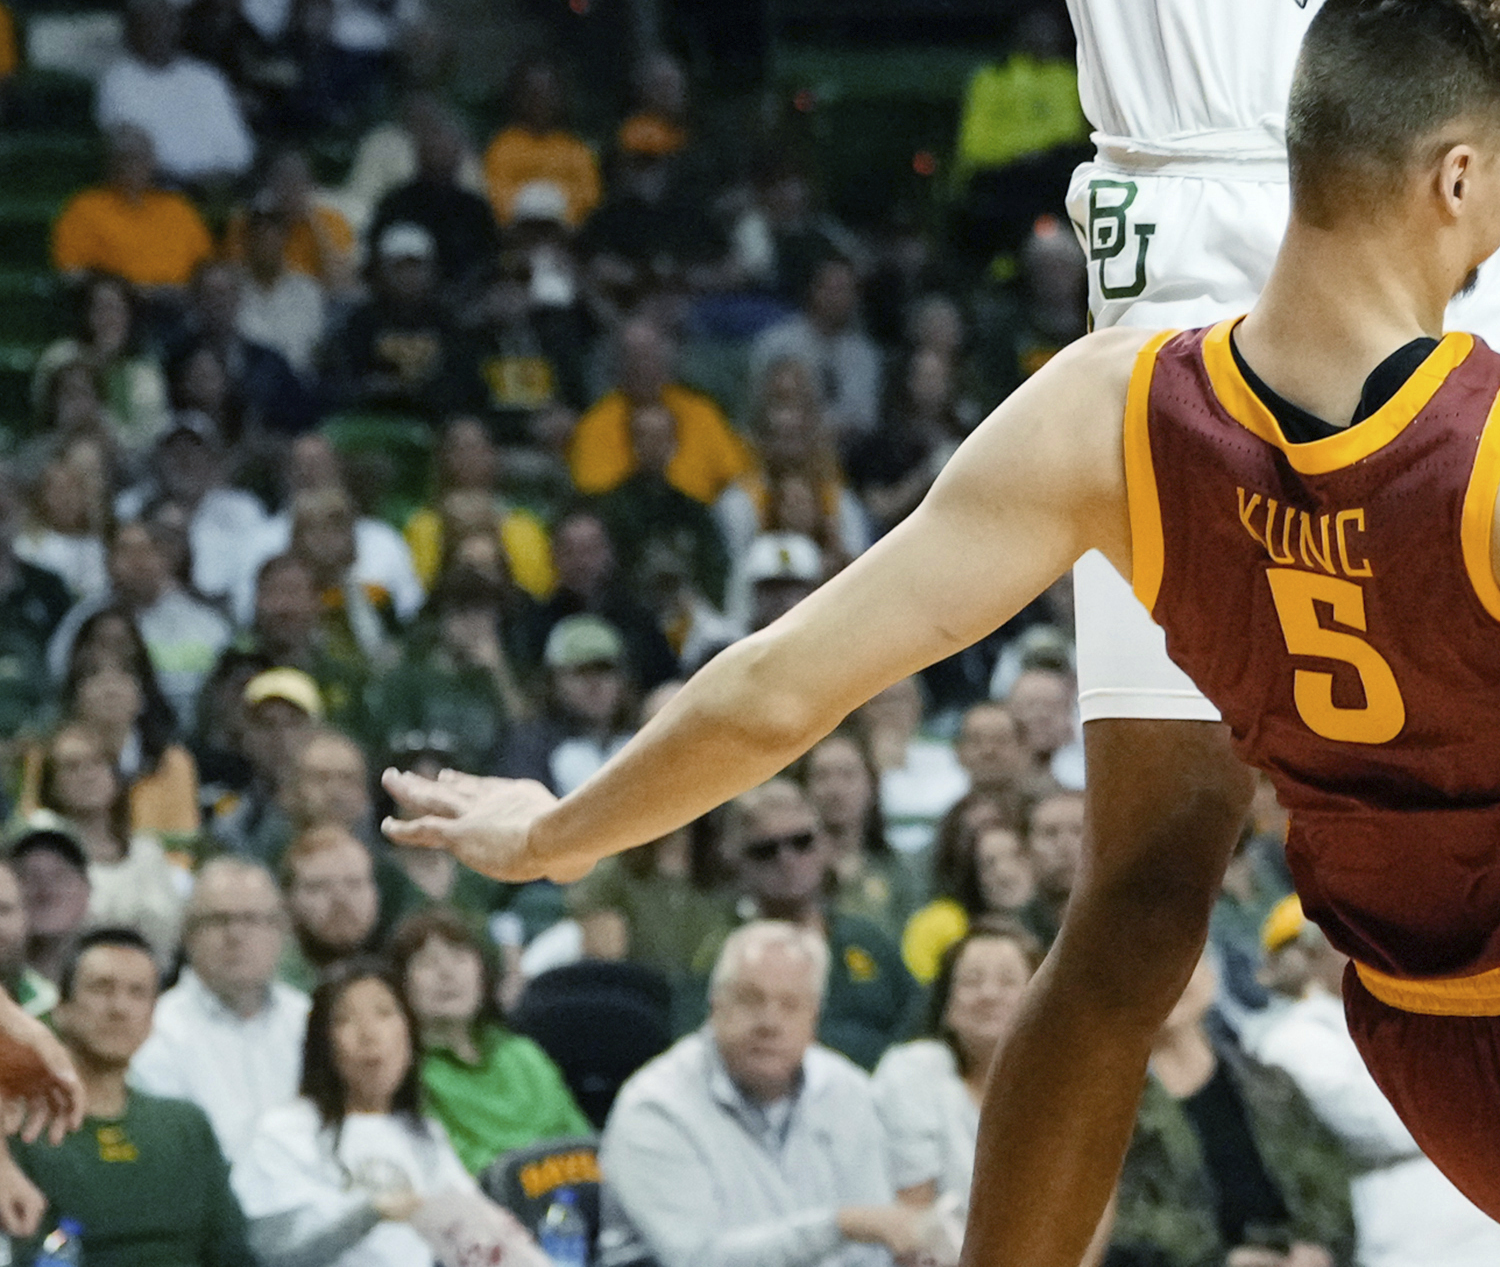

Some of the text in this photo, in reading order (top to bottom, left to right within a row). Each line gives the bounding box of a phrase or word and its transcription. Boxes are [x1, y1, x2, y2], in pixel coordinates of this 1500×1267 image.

[1088, 180, 1156, 300] BU
[1236, 487, 1373, 578] KUNC
[1266, 568, 1406, 744] 5
